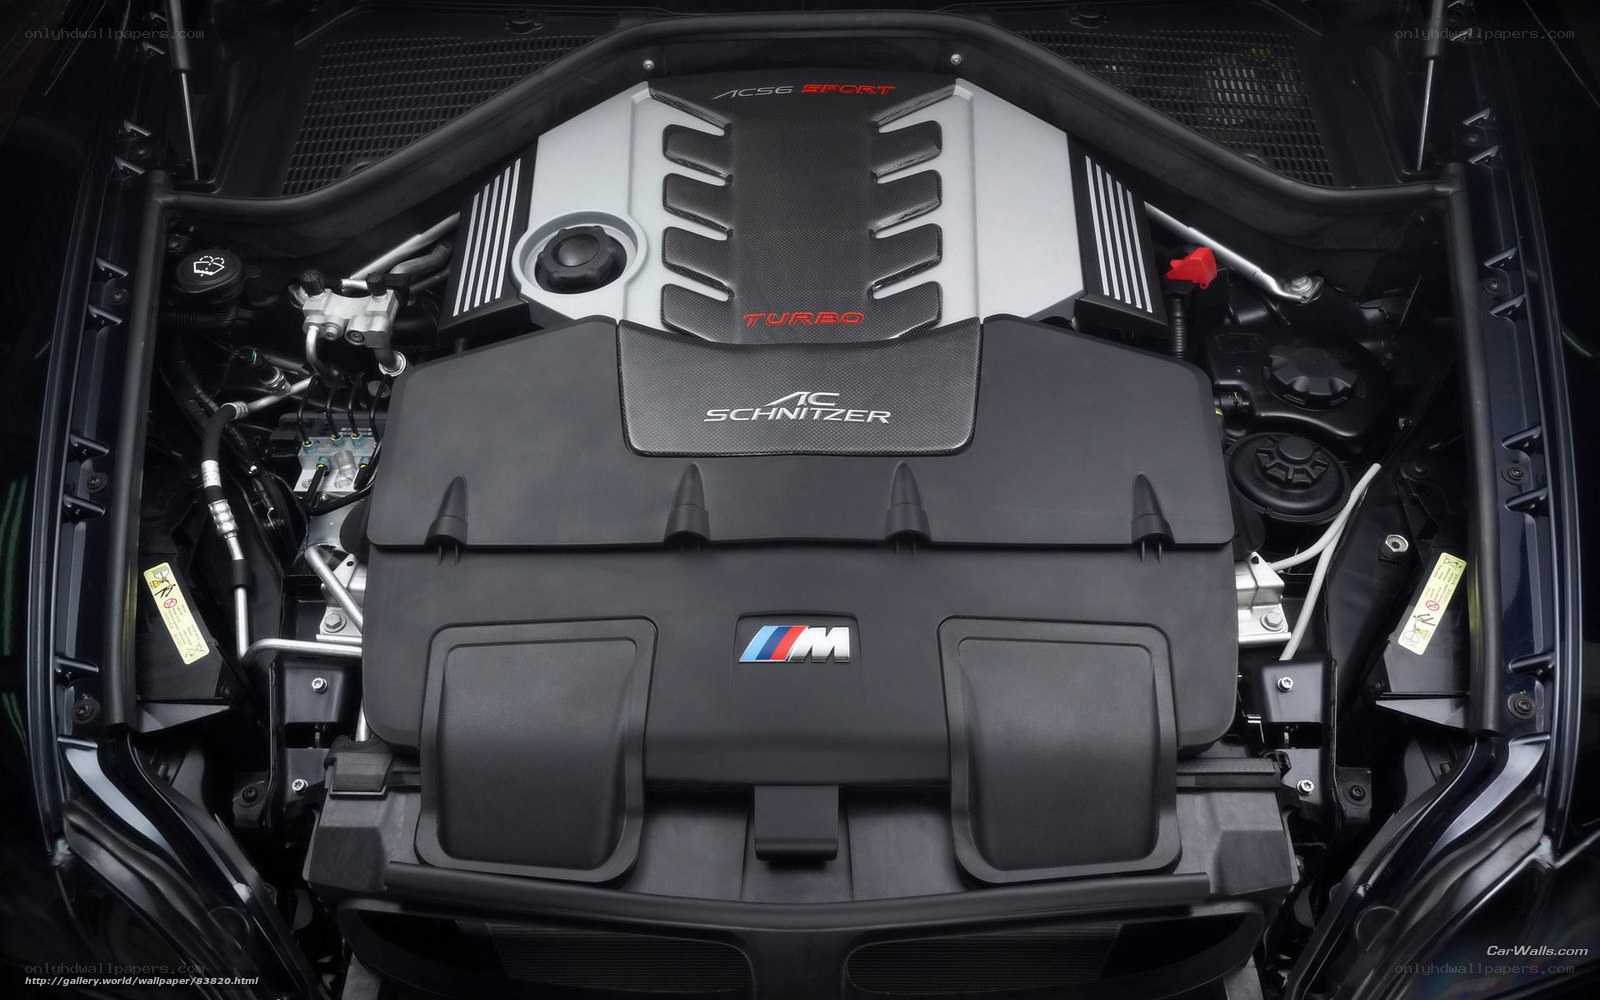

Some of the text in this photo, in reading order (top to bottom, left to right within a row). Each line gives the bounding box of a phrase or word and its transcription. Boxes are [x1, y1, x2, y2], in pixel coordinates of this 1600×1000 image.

[711, 84, 896, 100] ACS6 SPORT
[742, 311, 865, 327] TURBO
[764, 391, 840, 407] AC
[704, 407, 891, 424] SCHNITZER
[787, 626, 850, 663] M
